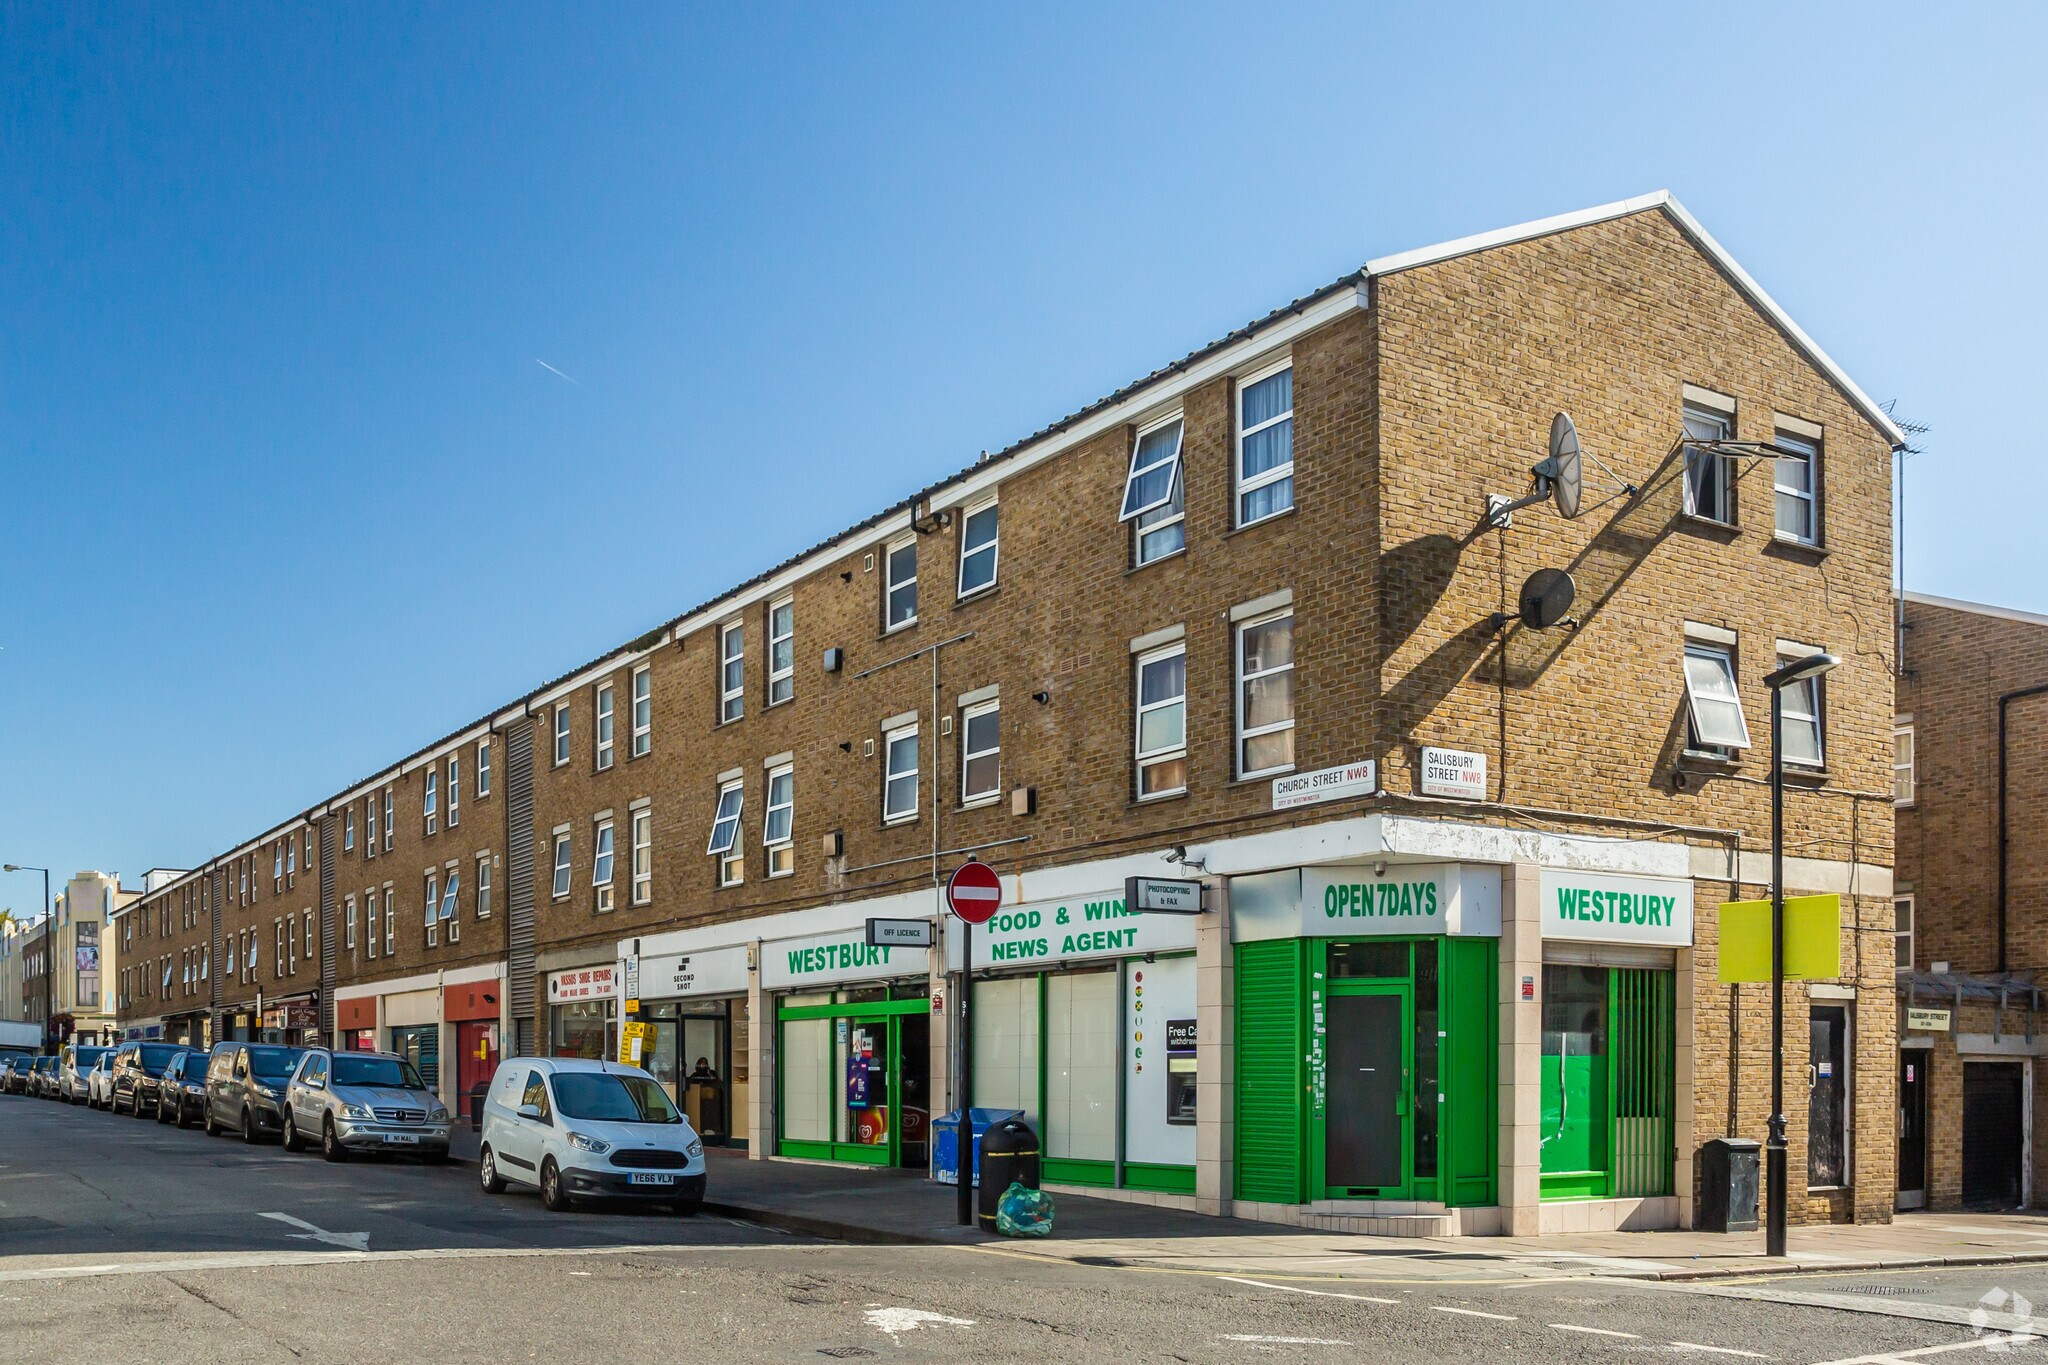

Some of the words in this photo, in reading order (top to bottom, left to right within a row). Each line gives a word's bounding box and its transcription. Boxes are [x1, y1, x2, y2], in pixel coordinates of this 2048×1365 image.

[1428, 752, 1474, 769] SALISBURY
[1277, 777, 1309, 794] CHURCH
[1312, 770, 1344, 787] STREET
[1347, 766, 1368, 781] NW8
[1428, 767, 1459, 781] STREET
[1462, 772, 1482, 785] NW8
[1443, 786, 1471, 795] WESTMINSTER
[1293, 794, 1320, 803] WESTMINSTER
[1148, 885, 1190, 895] PHOTOCOPYING
[1160, 897, 1165, 905] &
[1166, 897, 1178, 905] FAX
[1325, 884, 1374, 918] OPEN
[1558, 887, 1676, 927] WESTBURY
[988, 911, 1041, 934] FOOD
[1055, 906, 1070, 925] &
[1084, 898, 1143, 921] WIN
[897, 929, 920, 937] LICENCE
[992, 938, 1049, 961] NEWS
[1061, 928, 1138, 953] AGENT
[788, 941, 892, 974] WESTBURY
[579, 972, 590, 984] SHOE
[593, 969, 611, 982] REPAIRS
[673, 974, 694, 982] SECOND
[1168, 1026, 1187, 1036] Free
[634, 1173, 656, 1183] YE66
[657, 1173, 673, 1183] VLX
